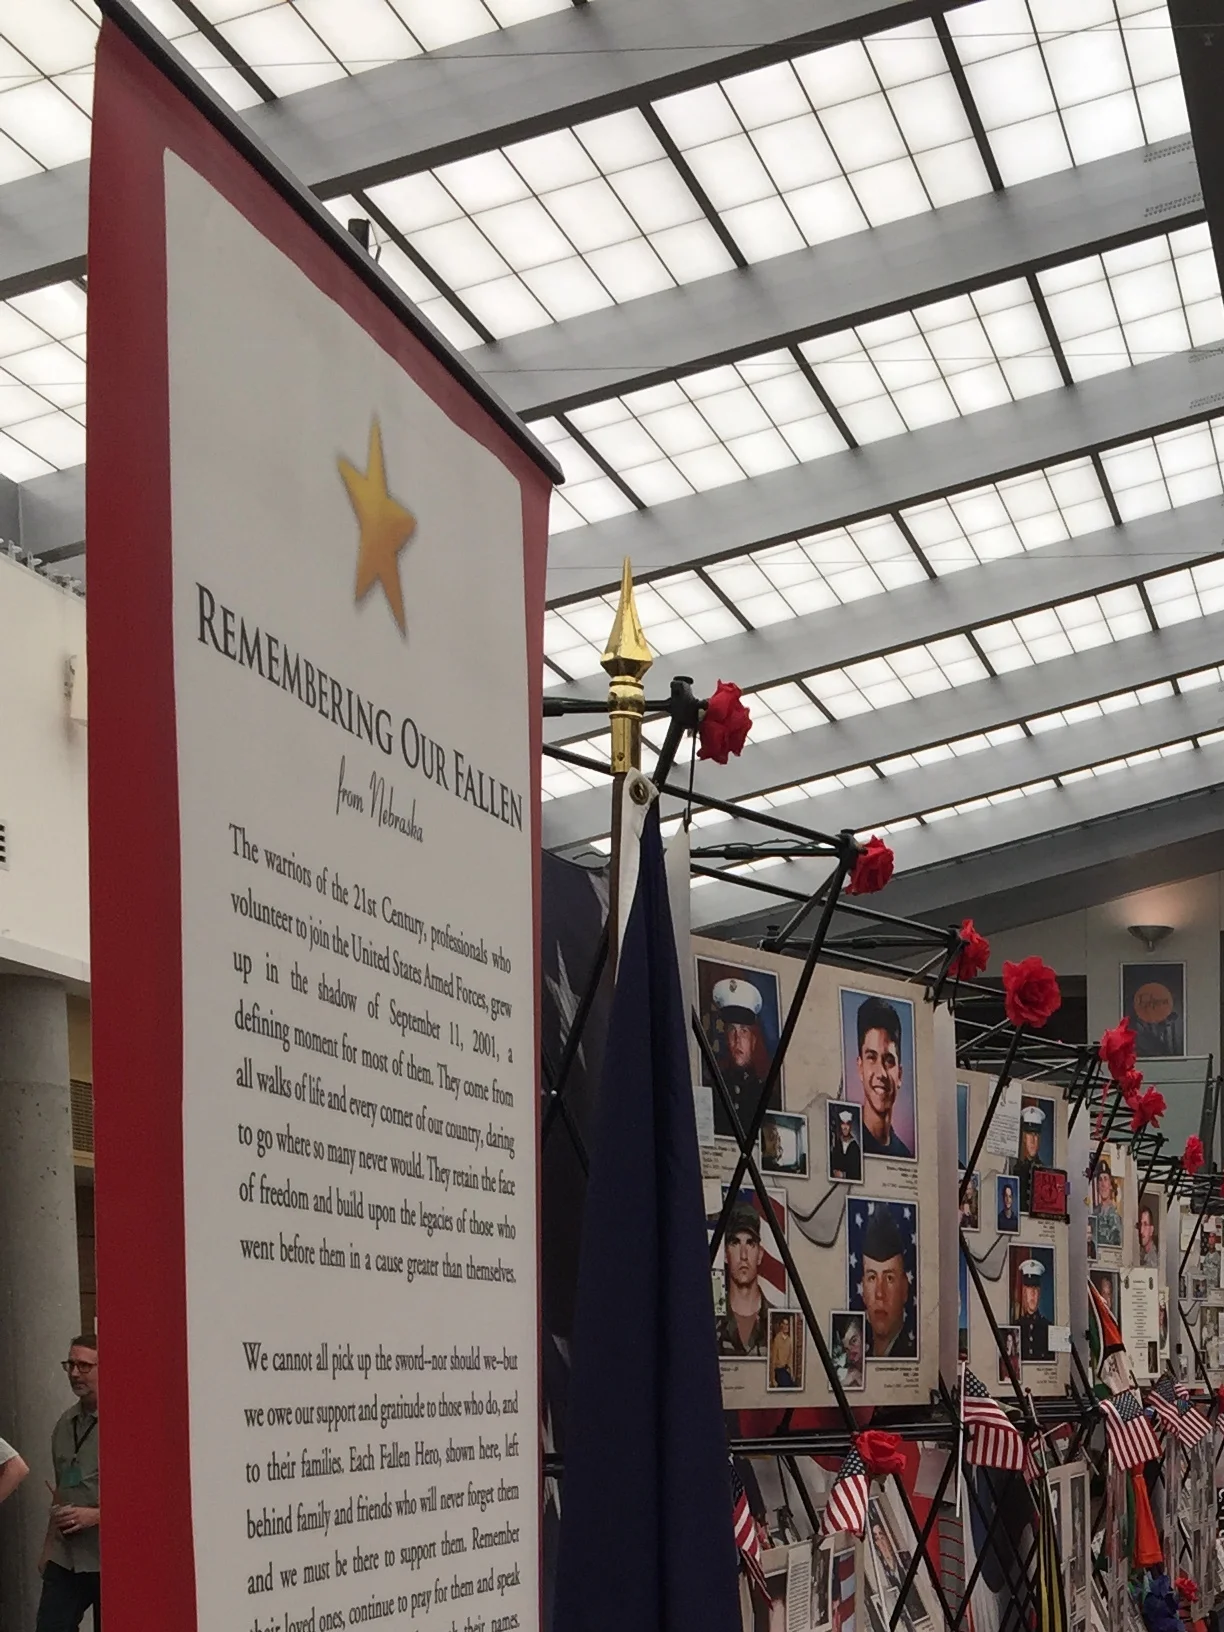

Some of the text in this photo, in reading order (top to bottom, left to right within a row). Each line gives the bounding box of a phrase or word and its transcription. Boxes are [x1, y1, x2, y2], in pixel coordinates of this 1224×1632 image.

[196, 582, 523, 833] REMEMBERING OUR FALLEN
[336, 755, 424, 843] from Nebraska
[229, 823, 511, 974] The warriors of the 21st Century, professionals who
[231, 887, 512, 1021] volunteer to join the United States Armed Forces, grew
[233, 952, 513, 1063] up in the shadow of September 11, 2001, a
[235, 999, 513, 1107] defining moment for most of them. They come from
[239, 1172, 516, 1240] of freedom and build upon the legacies of those who
[240, 1240, 275, 1261] went
[279, 1232, 315, 1265] before
[319, 1237, 345, 1268] them
[350, 1243, 361, 1269] in
[365, 1253, 371, 1270] a
[375, 1255, 403, 1273] cause
[407, 1258, 439, 1283] greater
[442, 1252, 463, 1278] than
[242, 1342, 268, 1371] We
[273, 1352, 313, 1371] cannot
[316, 1342, 329, 1371] all
[332, 1343, 354, 1380] pick
[357, 1354, 371, 1380] up
[375, 1344, 392, 1371] the
[450, 1345, 481, 1371] should
[246, 1432, 519, 1483] to their families. Each Fallen Hero, shown here, left
[247, 1478, 519, 1539] behind family and friends who will never forget them
[248, 1521, 520, 1595] and we must be there to support them. Remember
[319, 1610, 345, 1632] ones,
[349, 1594, 395, 1625] continue
[398, 1596, 408, 1613] to
[411, 1590, 432, 1618] pray
[434, 1578, 448, 1604] for
[451, 1574, 474, 1600] them
[477, 1567, 494, 1594] and
[497, 1562, 521, 1589] speak
